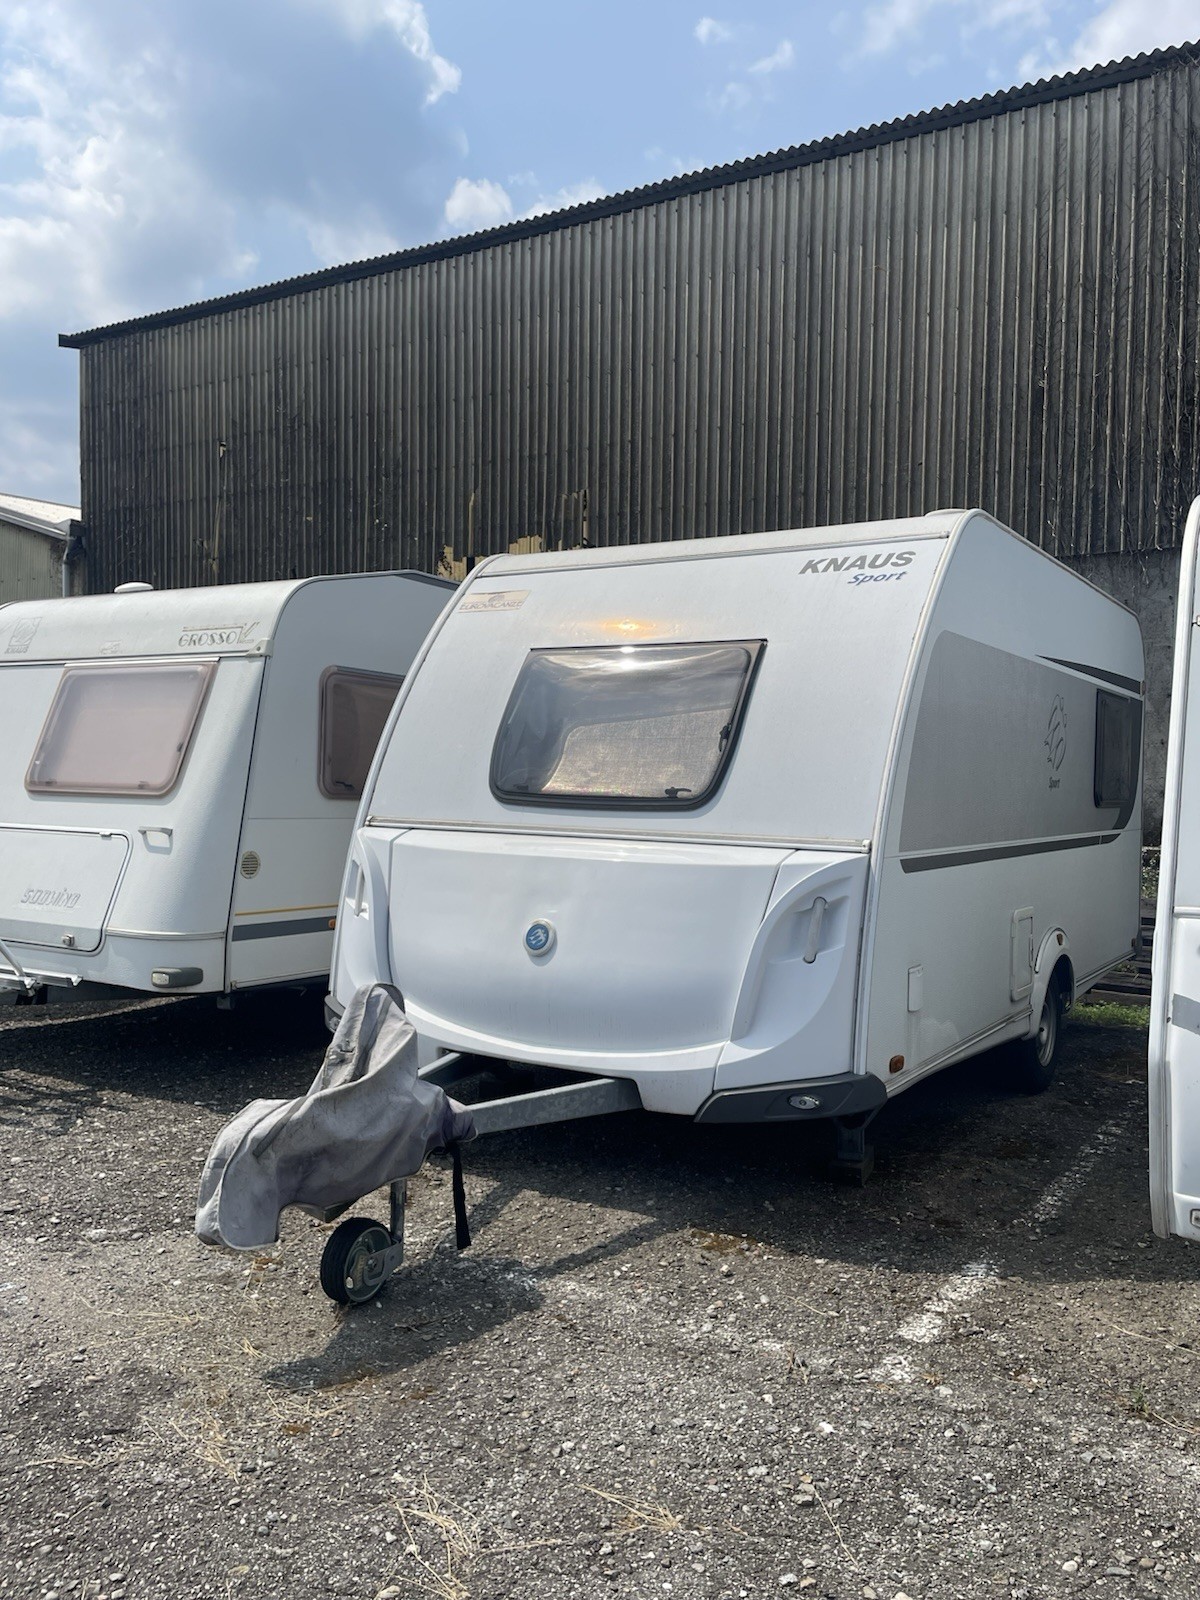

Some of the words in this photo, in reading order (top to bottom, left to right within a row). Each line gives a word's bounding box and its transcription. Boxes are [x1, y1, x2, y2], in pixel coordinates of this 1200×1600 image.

[798, 551, 917, 575] KNAUS
[847, 571, 907, 586] Sport
[178, 631, 237, 648] GROSSO
[1048, 776, 1061, 791] Sport
